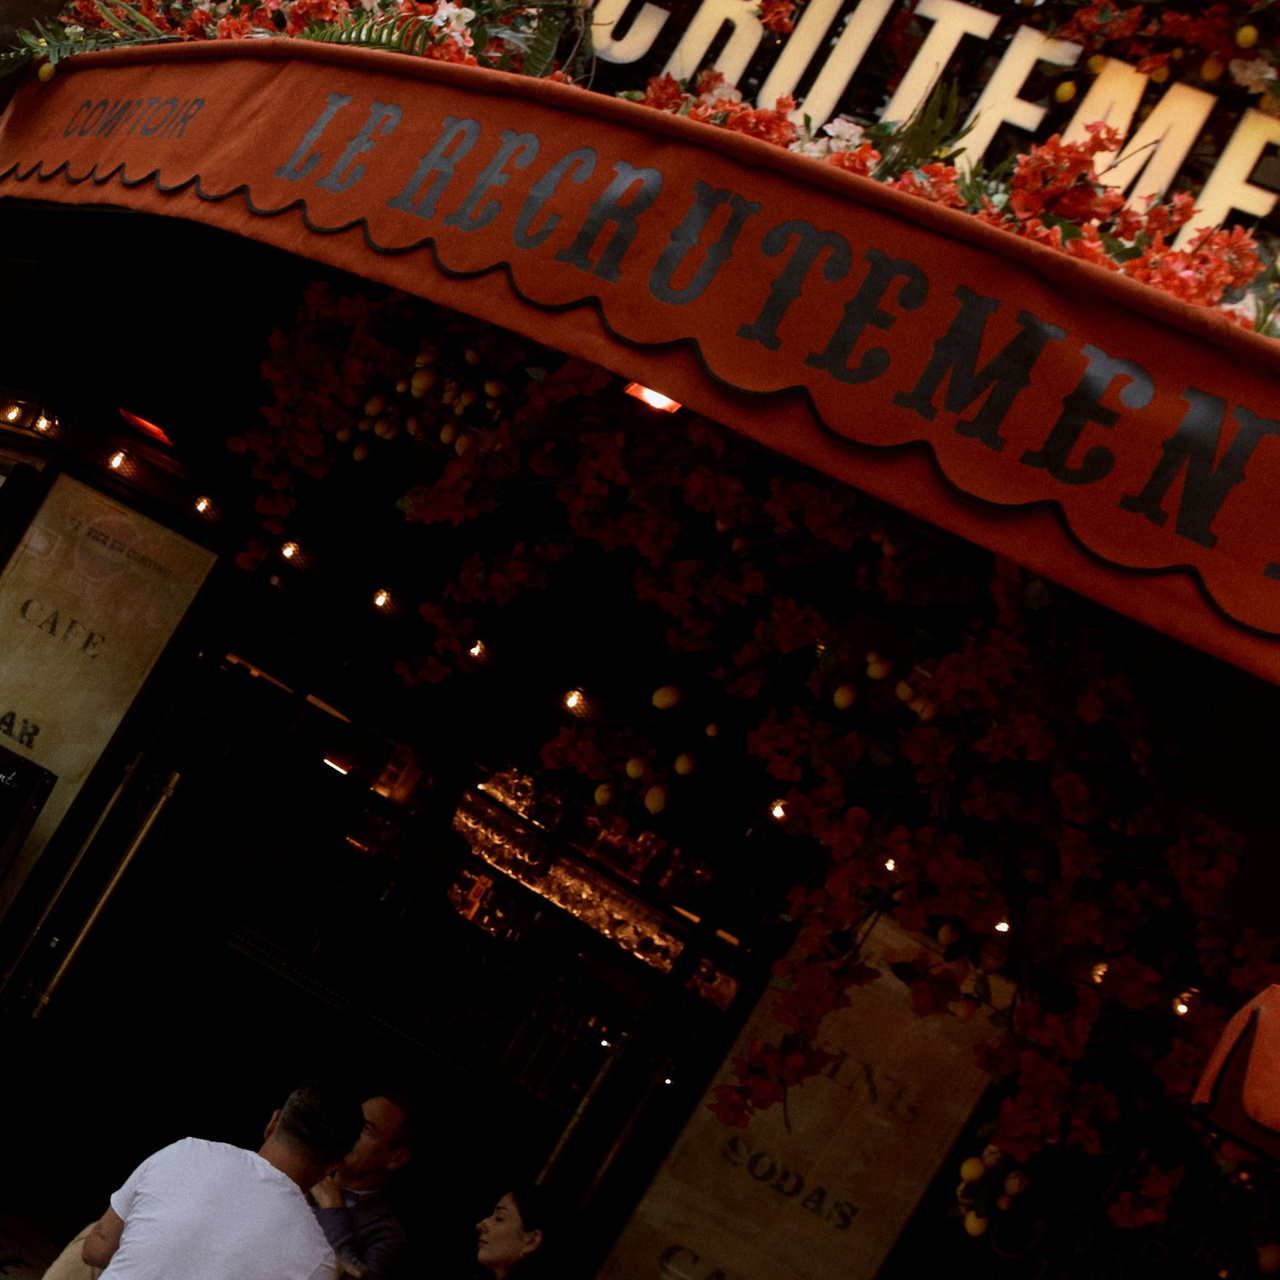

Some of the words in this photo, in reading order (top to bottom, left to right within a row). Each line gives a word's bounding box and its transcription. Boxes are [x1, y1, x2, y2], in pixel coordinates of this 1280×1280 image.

[62, 97, 206, 140] COMPTOIR
[275, 91, 403, 194] LE
[384, 115, 1280, 580] RECRUTEMEN
[20, 599, 106, 660] CAFE
[824, 1046, 923, 1125] INS
[722, 1136, 860, 1232] SODAS
